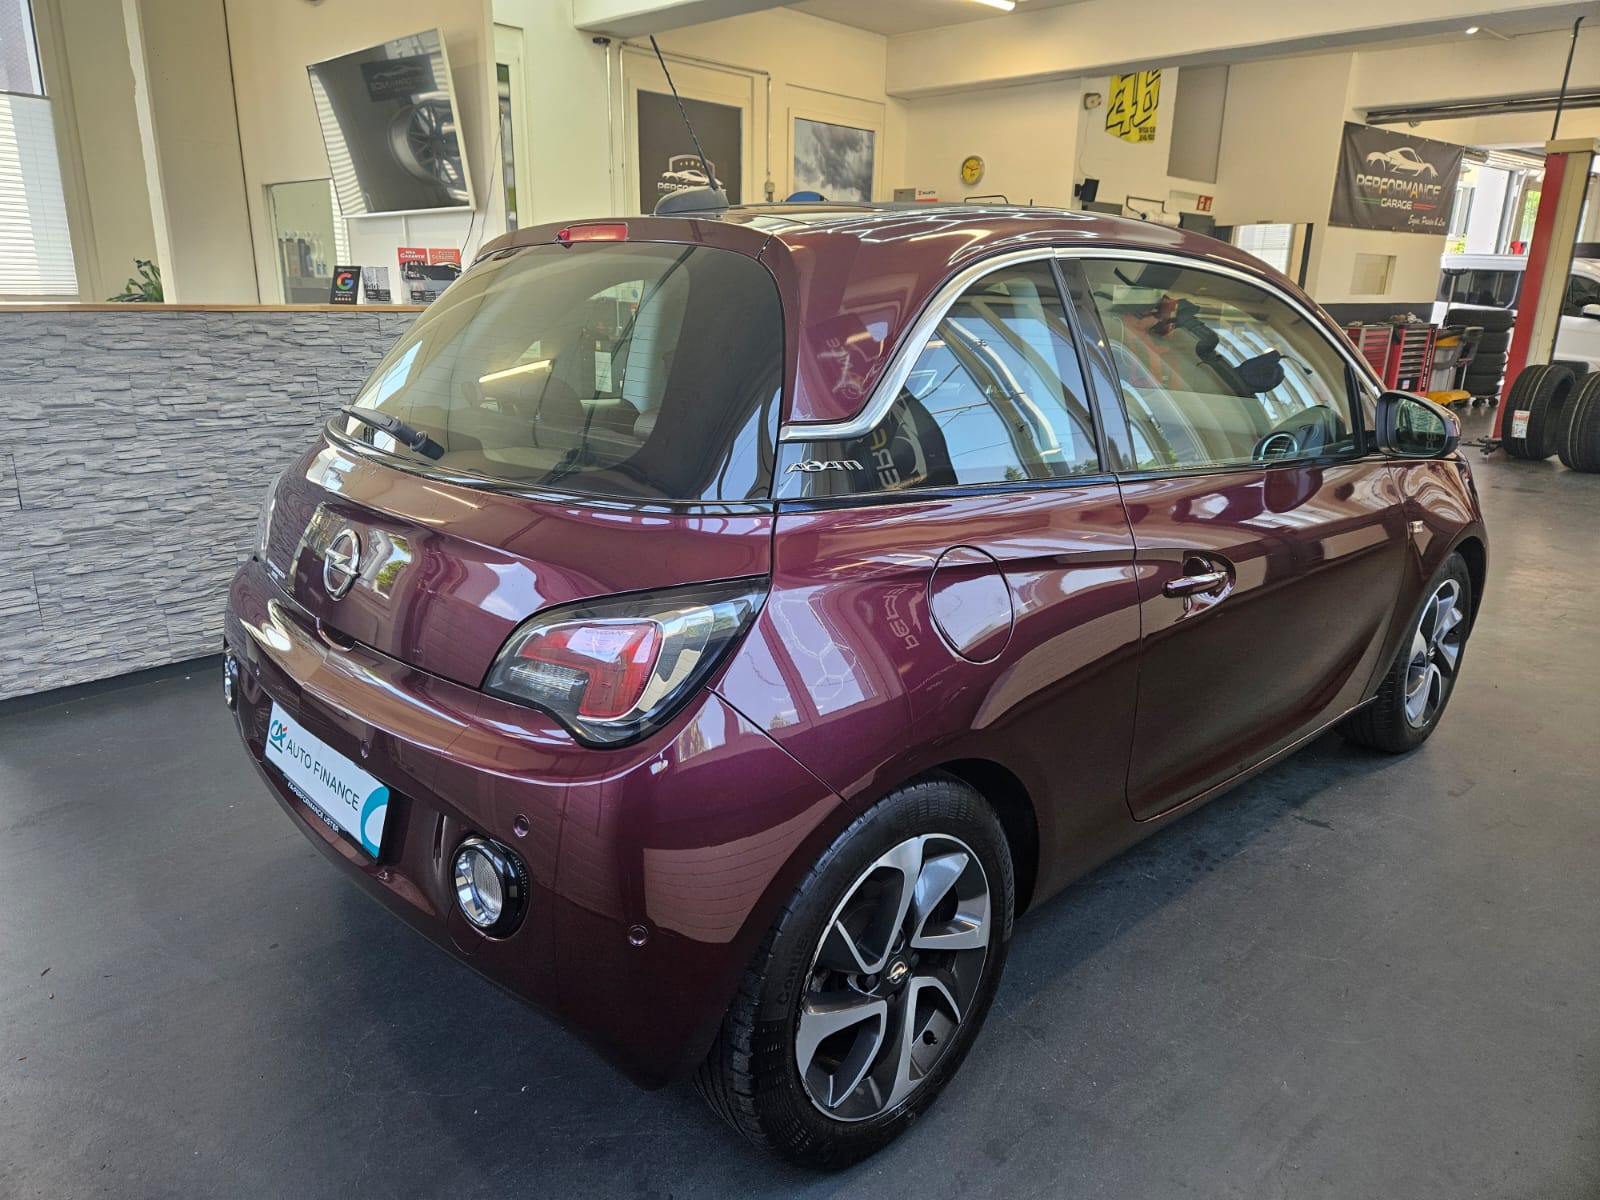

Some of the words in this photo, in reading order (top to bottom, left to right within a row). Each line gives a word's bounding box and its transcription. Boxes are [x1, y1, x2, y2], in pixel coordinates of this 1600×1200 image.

[1356, 173, 1442, 198] PERFORMANCE
[1380, 197, 1413, 210] GARAGE
[286, 738, 312, 769] AUTO
[313, 760, 360, 812] FINANCE
